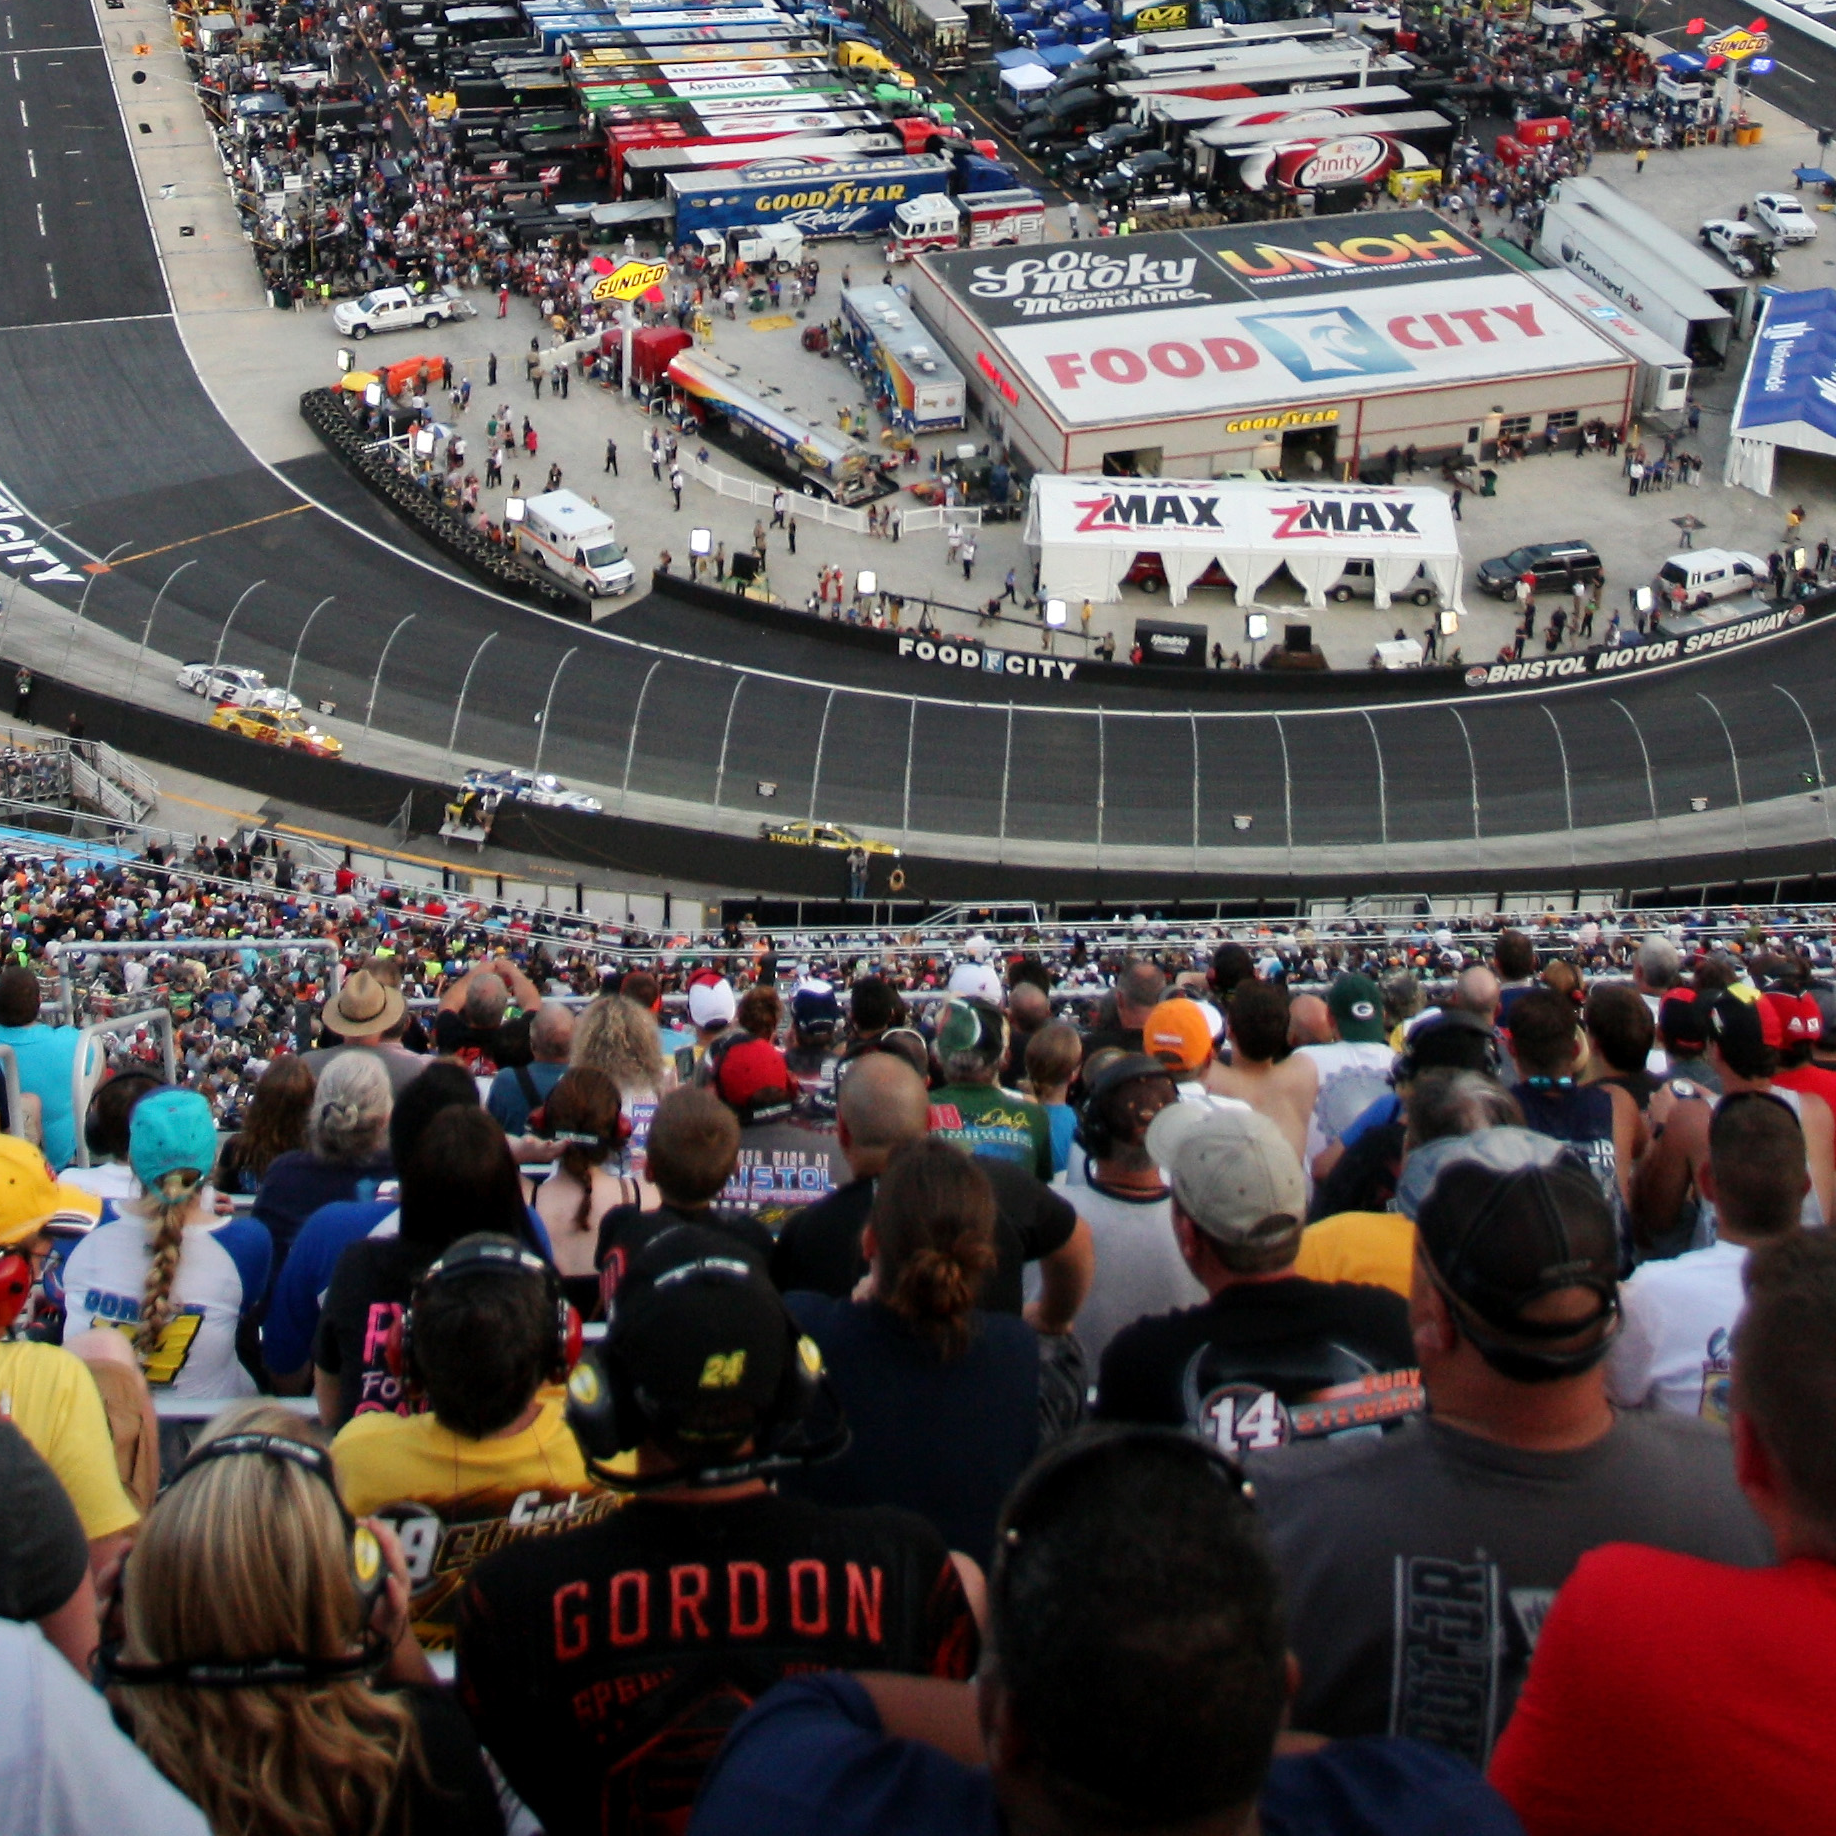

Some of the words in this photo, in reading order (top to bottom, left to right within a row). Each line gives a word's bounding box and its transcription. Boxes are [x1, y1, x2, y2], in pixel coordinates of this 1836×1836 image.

[1709, 37, 1766, 54] SUNOCO
[748, 160, 906, 180] GOODYEAR
[755, 181, 906, 212] GOODYEAR
[782, 205, 868, 231] Racing
[1046, 250, 1127, 272] Ole
[1217, 229, 1476, 277] UNOH
[595, 266, 665, 297] SUNOCO
[969, 253, 1198, 298] Smoky
[1248, 270, 1321, 285] UNIVERSITY
[1326, 269, 1343, 278] OF
[1344, 258, 1447, 276] NORTHWESTERN
[1449, 254, 1482, 265] OHIO
[1574, 250, 1623, 300] Forward
[1624, 292, 1644, 313] Air
[1013, 288, 1212, 316] Moonshine
[1045, 337, 1260, 391] FOOD
[1387, 303, 1545, 352] CITY
[1764, 339, 1794, 393] Nationwide
[1225, 410, 1339, 434] GOODYEAR
[1150, 633, 1191, 647] Hendrick
[1487, 656, 1587, 685] BRISTOL
[1596, 640, 1679, 671] MOTOR
[1684, 610, 1789, 655] SPEEDWAY
[898, 638, 980, 669] FOOD
[1005, 654, 1078, 681] CITY
[222, 685, 237, 701] 2
[255, 725, 278, 741] 22
[699, 1350, 747, 1389] 24
[1211, 1391, 1285, 1452] 14
[509, 1490, 578, 1527] Carl
[552, 1559, 884, 1661] GORDON
